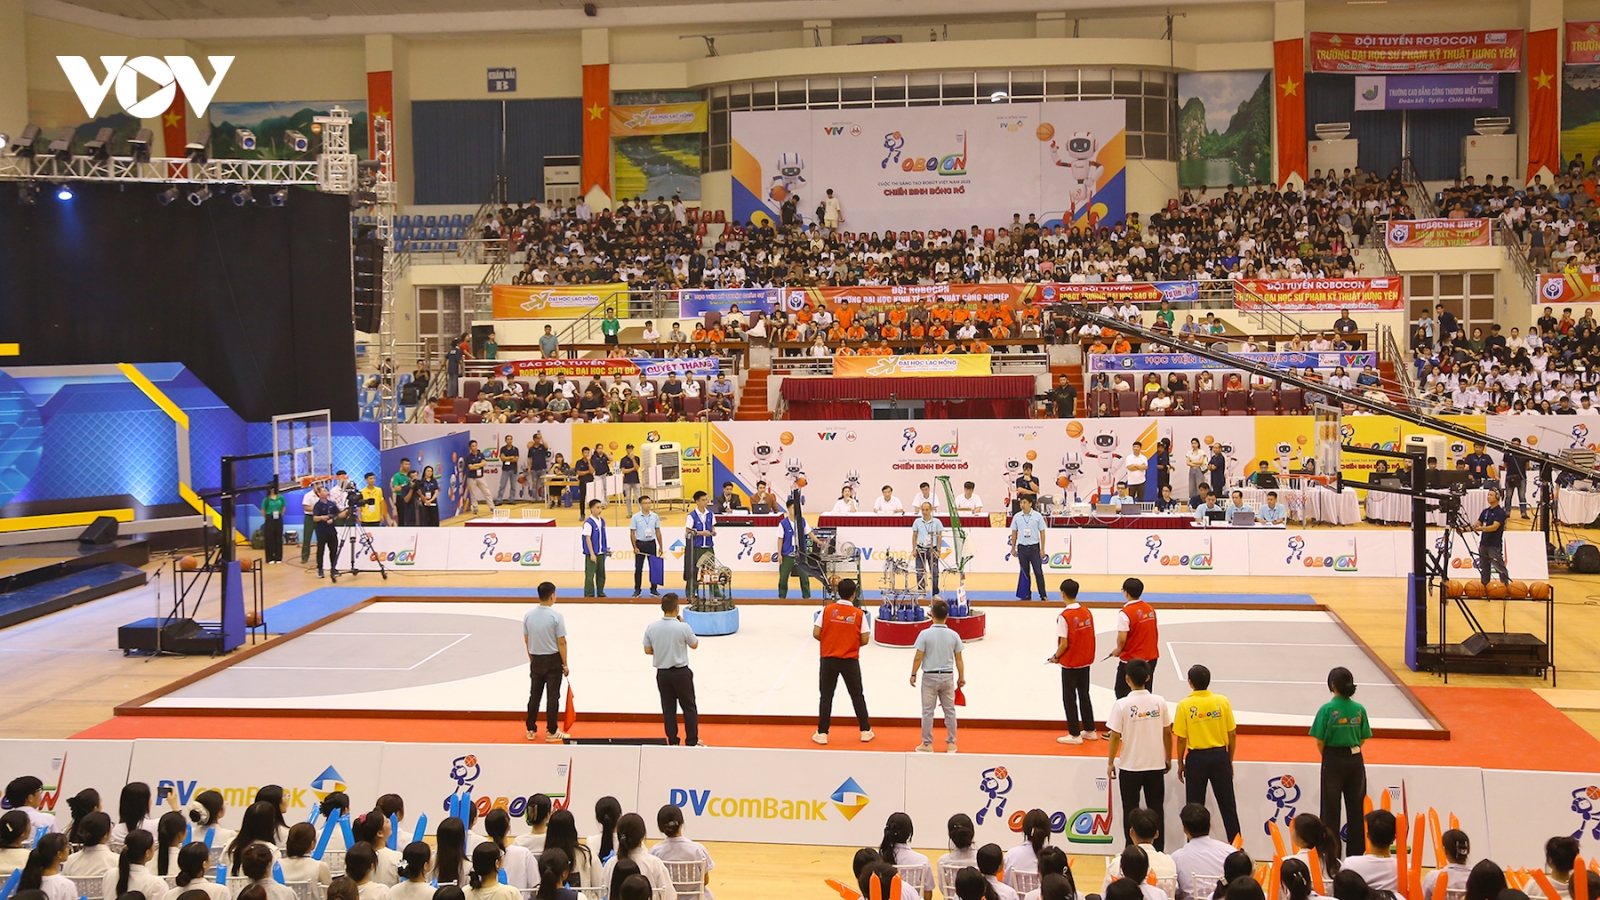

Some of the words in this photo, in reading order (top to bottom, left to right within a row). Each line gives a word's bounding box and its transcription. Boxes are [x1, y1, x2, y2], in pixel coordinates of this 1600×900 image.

[1355, 37, 1376, 48] ĐỘI
[1379, 34, 1413, 45] TUYỂN
[1416, 36, 1478, 45] ROBOCON
[1316, 48, 1350, 60] TRƯỜNG
[1352, 50, 1366, 61] ĐẠI
[1368, 50, 1386, 61] HỌC
[1402, 50, 1427, 61] PHẠM
[1429, 48, 1440, 59] KỸ
[1443, 48, 1469, 60] THUẬT
[1472, 48, 1496, 59] HƯNG
[1499, 47, 1517, 59] YÊN
[496, 81, 509, 90] B
[1432, 87, 1444, 95] CÔNG
[1416, 221, 1455, 229] ROBOCON
[892, 286, 906, 295] ĐỘI
[910, 285, 950, 294] ROBOCON
[1267, 282, 1284, 292] ĐỘI
[1285, 279, 1314, 290] TUYỂN
[1316, 281, 1365, 289] ROBOCON
[864, 296, 875, 304] ĐẠI
[877, 296, 892, 304] HỌC
[962, 293, 982, 301] CÔNG
[984, 292, 1009, 301] NGHIỆP
[1278, 293, 1292, 303] HỌC
[1305, 292, 1326, 303] PHẠM
[1338, 291, 1361, 302] THUẬT
[1362, 291, 1382, 300] HƯNG
[1384, 290, 1398, 300] YÊN
[1146, 356, 1168, 365] HỌC
[1172, 355, 1196, 365] VIỆN
[1345, 355, 1371, 365] VTV
[576, 368, 588, 376] ĐẠI
[670, 788, 828, 821] PVcomBank
